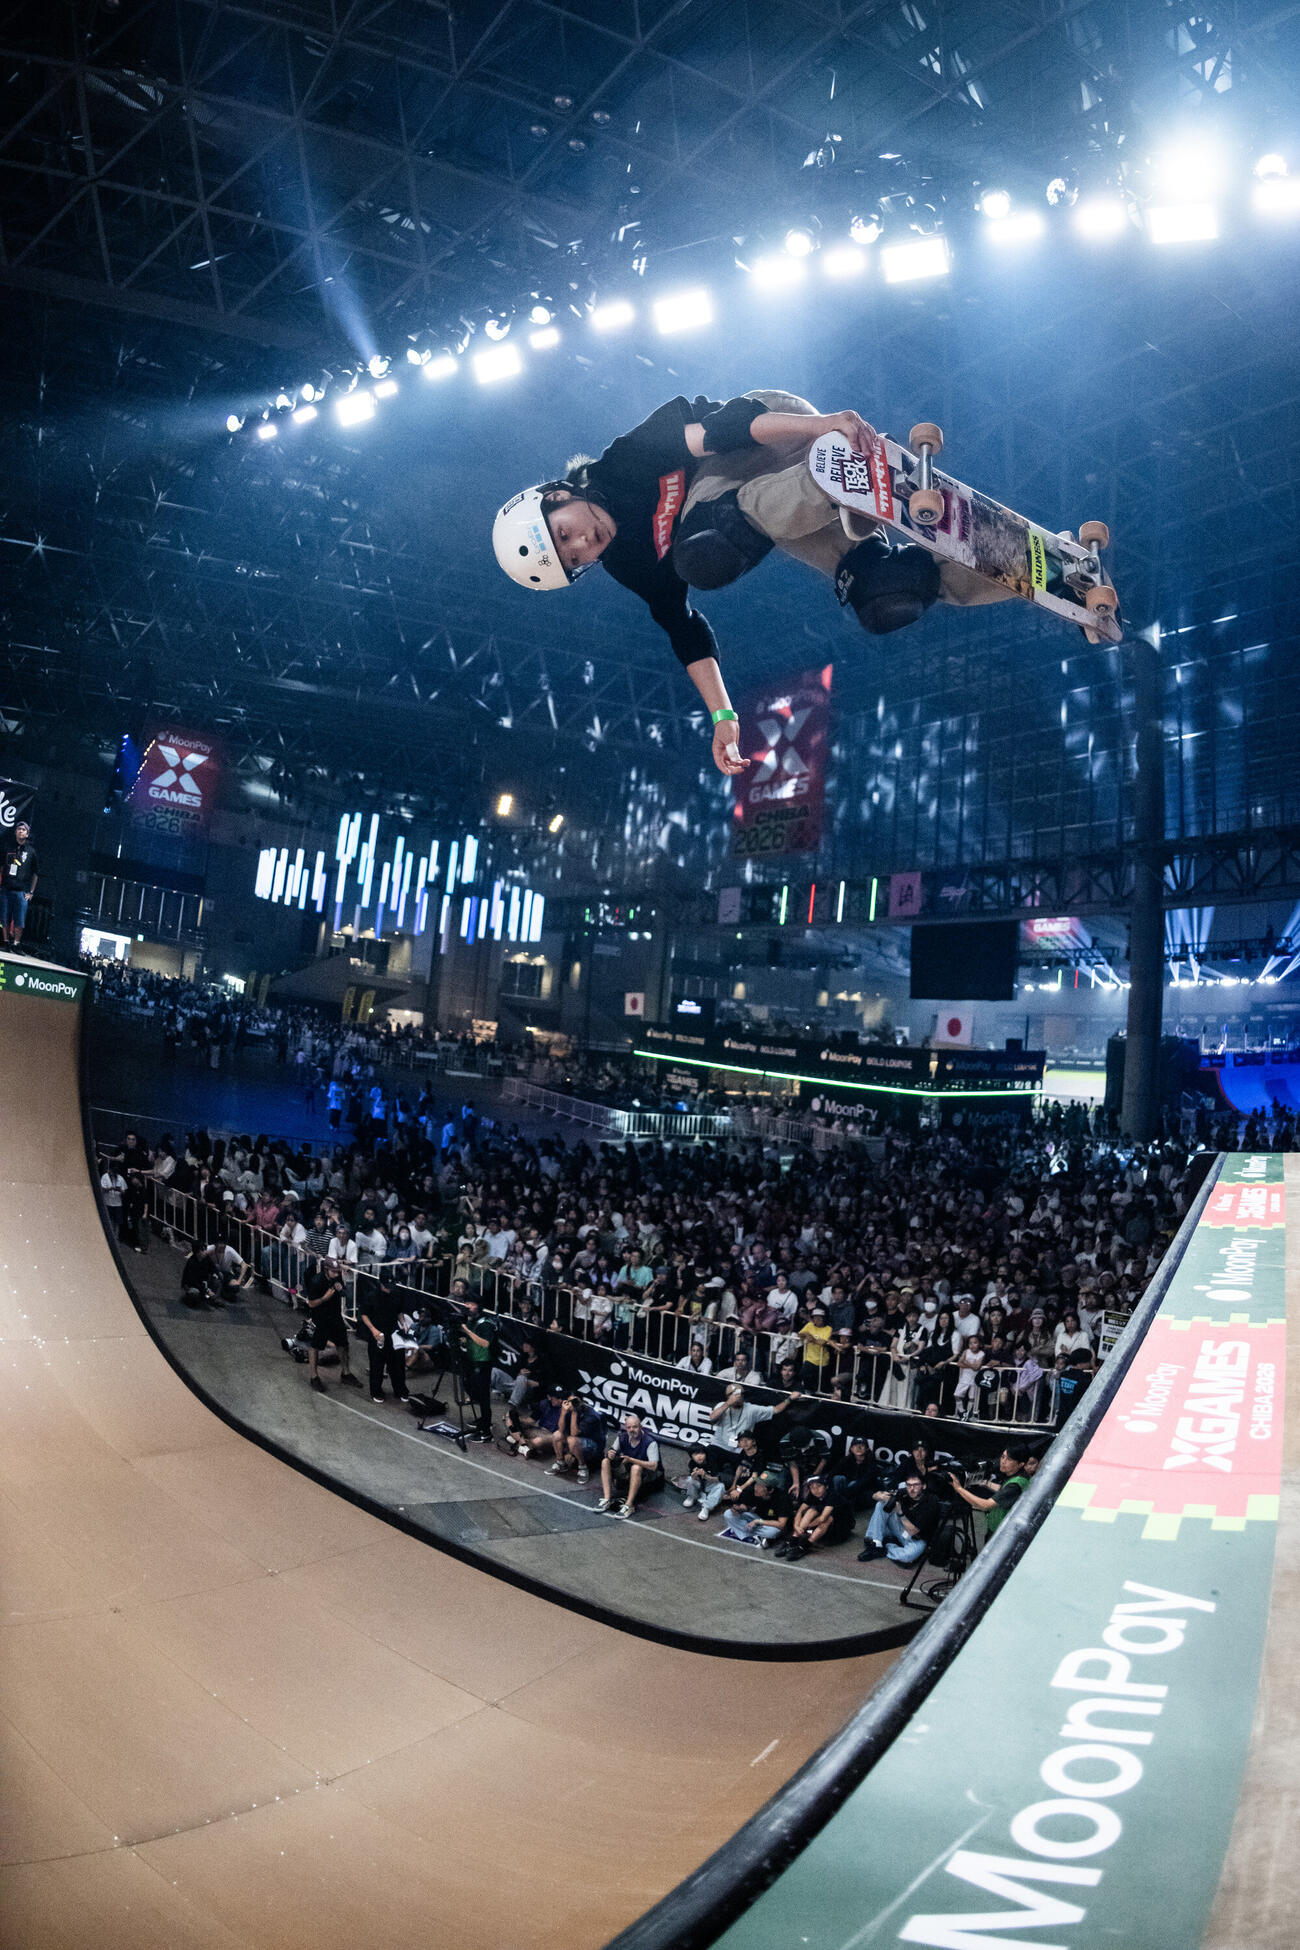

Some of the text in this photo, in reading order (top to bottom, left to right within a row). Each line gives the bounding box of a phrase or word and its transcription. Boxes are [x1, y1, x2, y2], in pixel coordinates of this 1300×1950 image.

[815, 447, 827, 474] BELIEVE
[854, 458, 870, 493] DECK
[842, 461, 855, 491] TECH
[1032, 534, 1043, 587] MADNESS
[168, 734, 213, 754] MoonPay
[149, 786, 202, 807] GAMES
[1033, 921, 1071, 933] GAMES
[28, 976, 78, 998] MoonPay
[828, 1051, 862, 1066] MoonPay
[1209, 1237, 1268, 1286] MoonPay
[628, 1366, 699, 1399] MoonPay
[1130, 1362, 1185, 1417] MoonPay
[898, 1580, 1217, 1950] MoonPay
